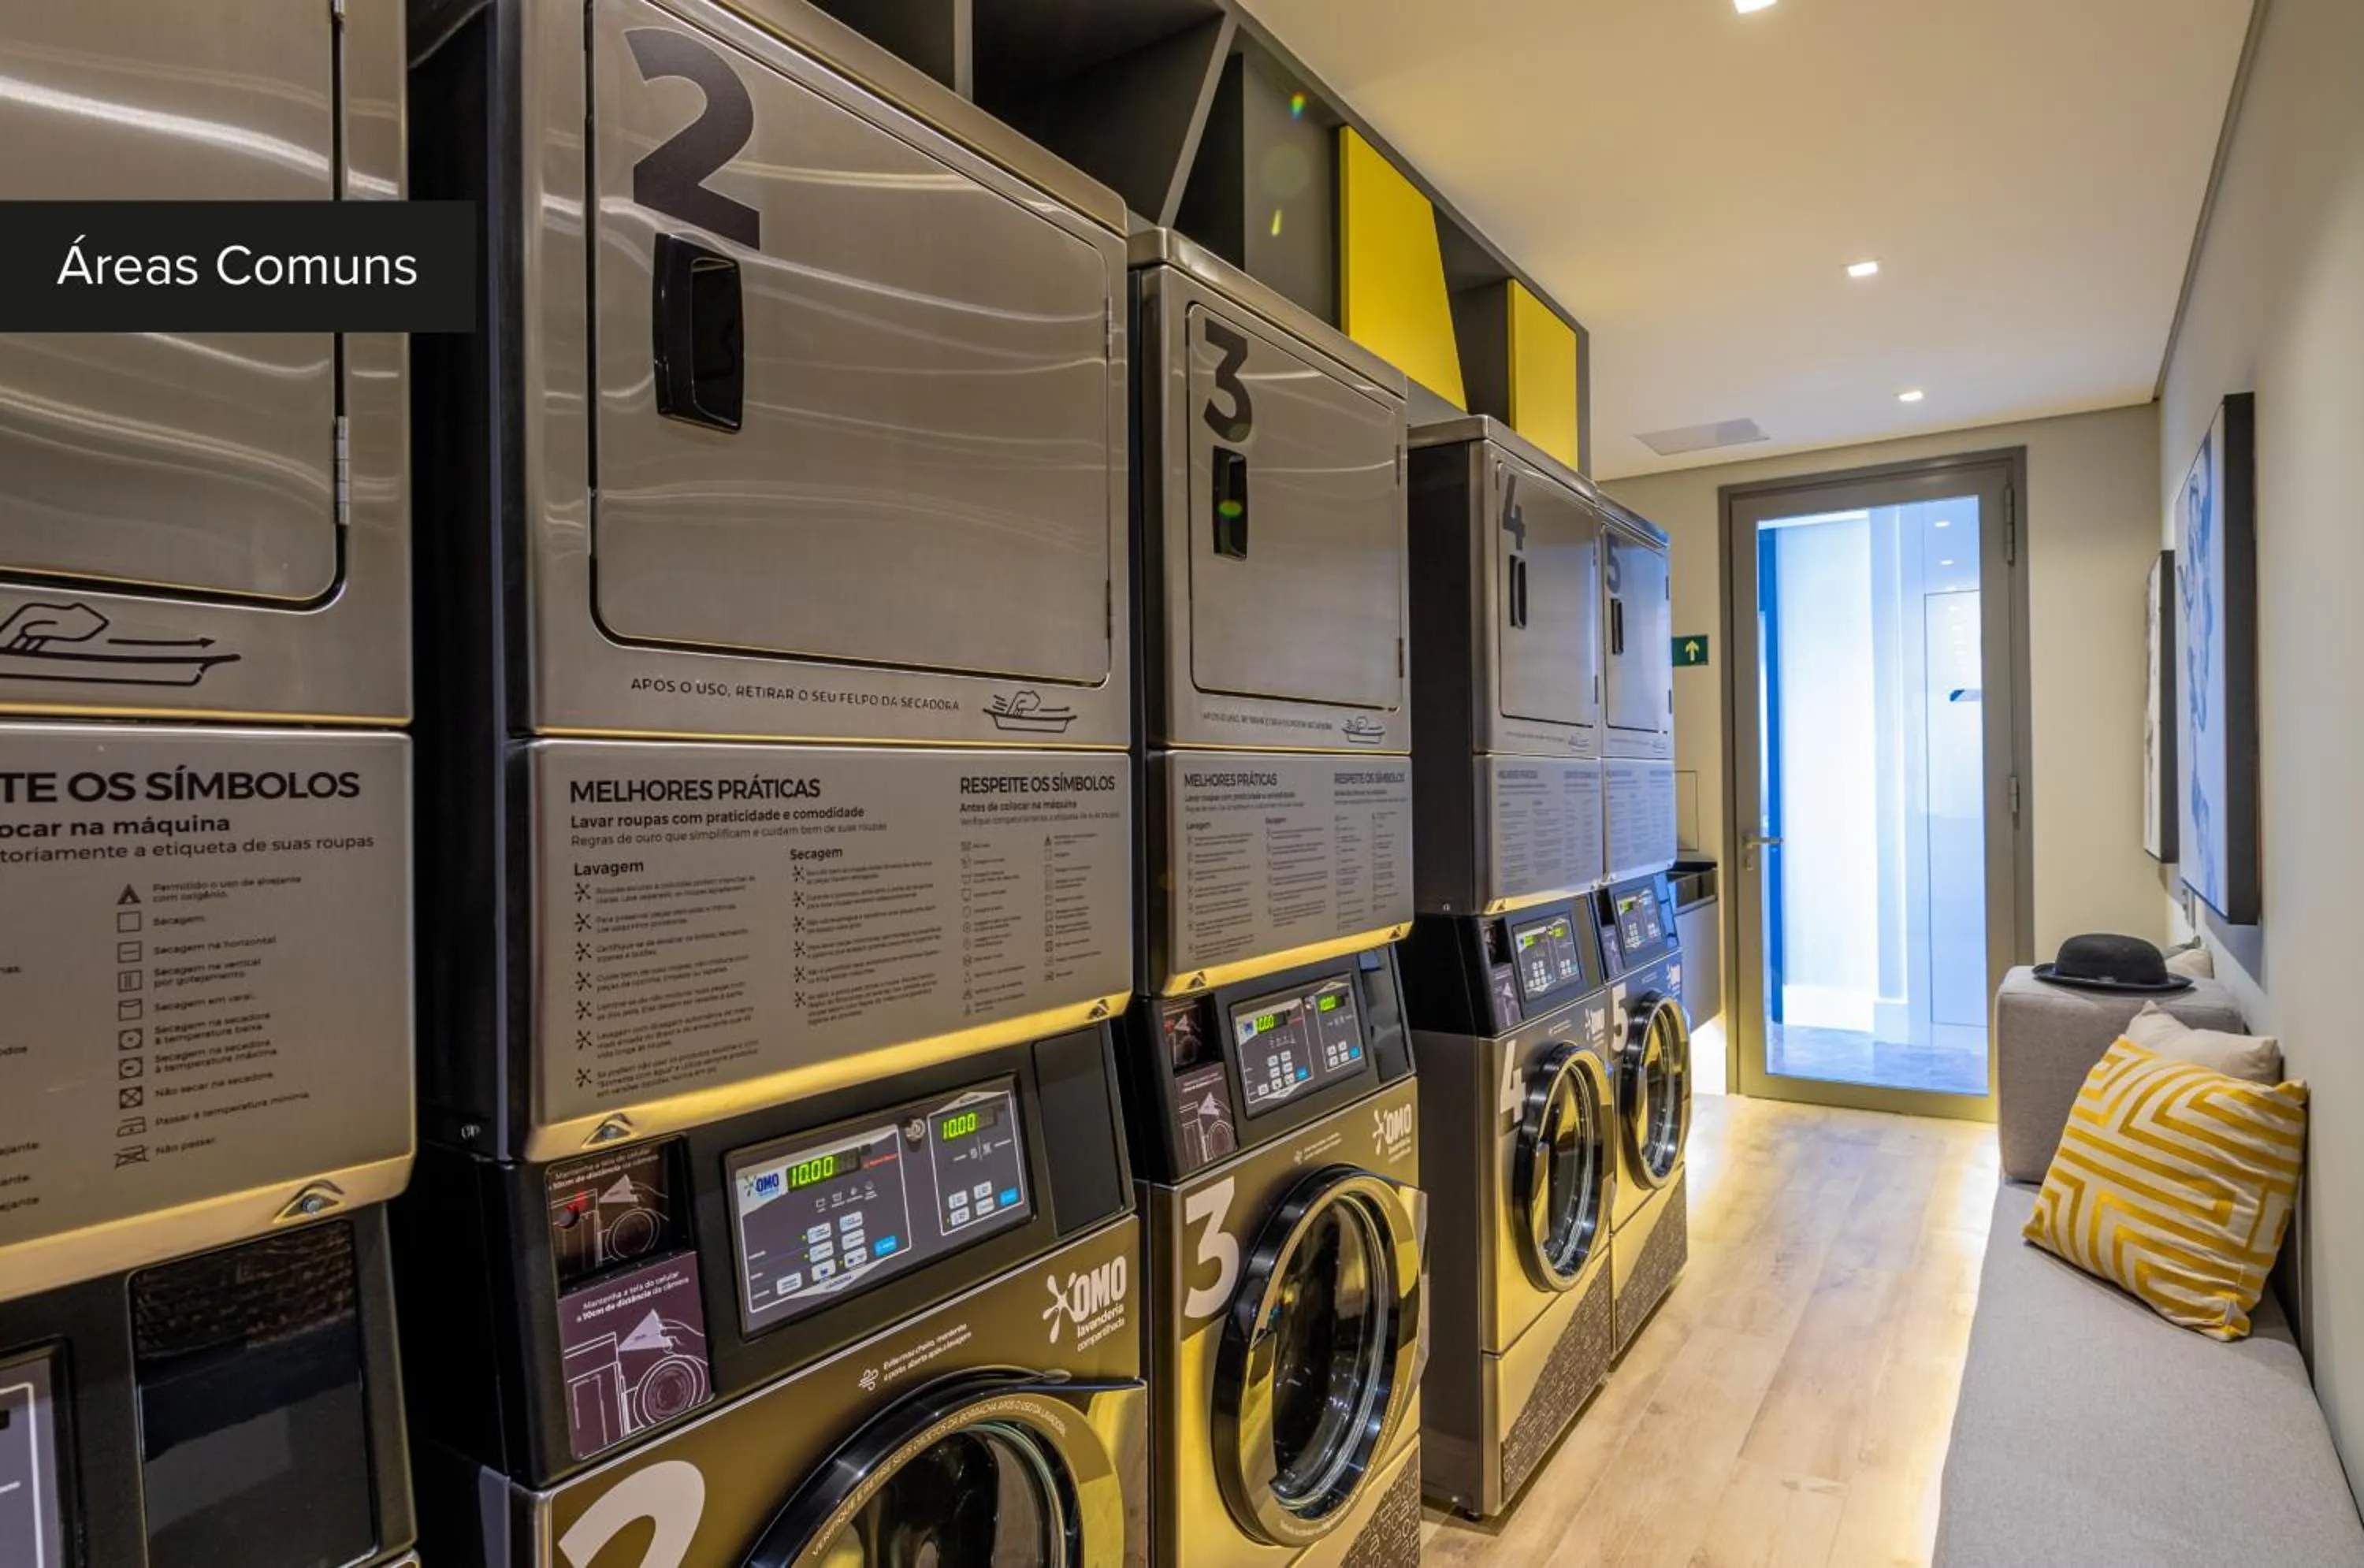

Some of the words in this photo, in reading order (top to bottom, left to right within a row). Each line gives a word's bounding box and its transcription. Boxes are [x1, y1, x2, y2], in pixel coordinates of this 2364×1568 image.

[626, 28, 760, 250] 2
[1202, 317, 1253, 443] 3
[1502, 474, 1526, 551] 4
[1606, 531, 1622, 594] 5
[680, 682, 692, 693] O
[736, 685, 795, 700] RETIRAR
[798, 689, 808, 700] O
[812, 690, 837, 703] SEU
[839, 693, 879, 706] FELPO
[882, 696, 898, 708] DA
[901, 696, 960, 711] SECADORA
[67, 771, 136, 803] OS
[146, 765, 360, 801] SÍMBOLOS
[570, 779, 713, 803] MELHORES
[718, 774, 821, 800] PRÁTICAS
[961, 776, 1028, 794] RESPEITE
[1031, 776, 1050, 793] OS
[1052, 772, 1116, 792] SÍMBOLOS
[1184, 774, 1236, 787] MELHORES
[1237, 770, 1278, 786] PRÁTICAS
[571, 816, 614, 828] Lavar
[617, 814, 669, 828] roupas
[672, 813, 703, 826] com
[706, 808, 780, 826] praticidade
[783, 812, 790, 820] e
[793, 806, 864, 820] comodidade
[960, 802, 985, 813] Antes
[987, 802, 998, 812] de
[1000, 801, 1029, 811] colocar
[70, 819, 104, 837] na
[113, 815, 230, 836] máquina
[571, 834, 615, 849] Regras
[617, 833, 632, 844] de
[636, 834, 663, 843] ouro
[665, 833, 688, 845] que
[690, 827, 751, 841] simplificam
[133, 847, 146, 857] a
[153, 842, 237, 860] etiqueta
[243, 838, 266, 853] de
[273, 838, 311, 851] suas
[317, 834, 375, 849] roupas
[790, 848, 843, 861] Secagem
[574, 860, 645, 877] Lavagem
[153, 881, 207, 892] Permitido
[154, 944, 205, 956] Secagem
[154, 964, 205, 978] Secagem
[1612, 982, 1629, 1052] 5
[1500, 1039, 1526, 1120] 4
[943, 1112, 977, 1141] 10.00
[1386, 1103, 1412, 1145] OMO
[756, 1172, 780, 1193] OMO
[792, 1155, 834, 1187] 10.00
[1184, 1176, 1240, 1319] 3
[1073, 1256, 1127, 1323] OMO
[1077, 1302, 1124, 1339] lavanderia
[1077, 1317, 1125, 1353] compartilhada
